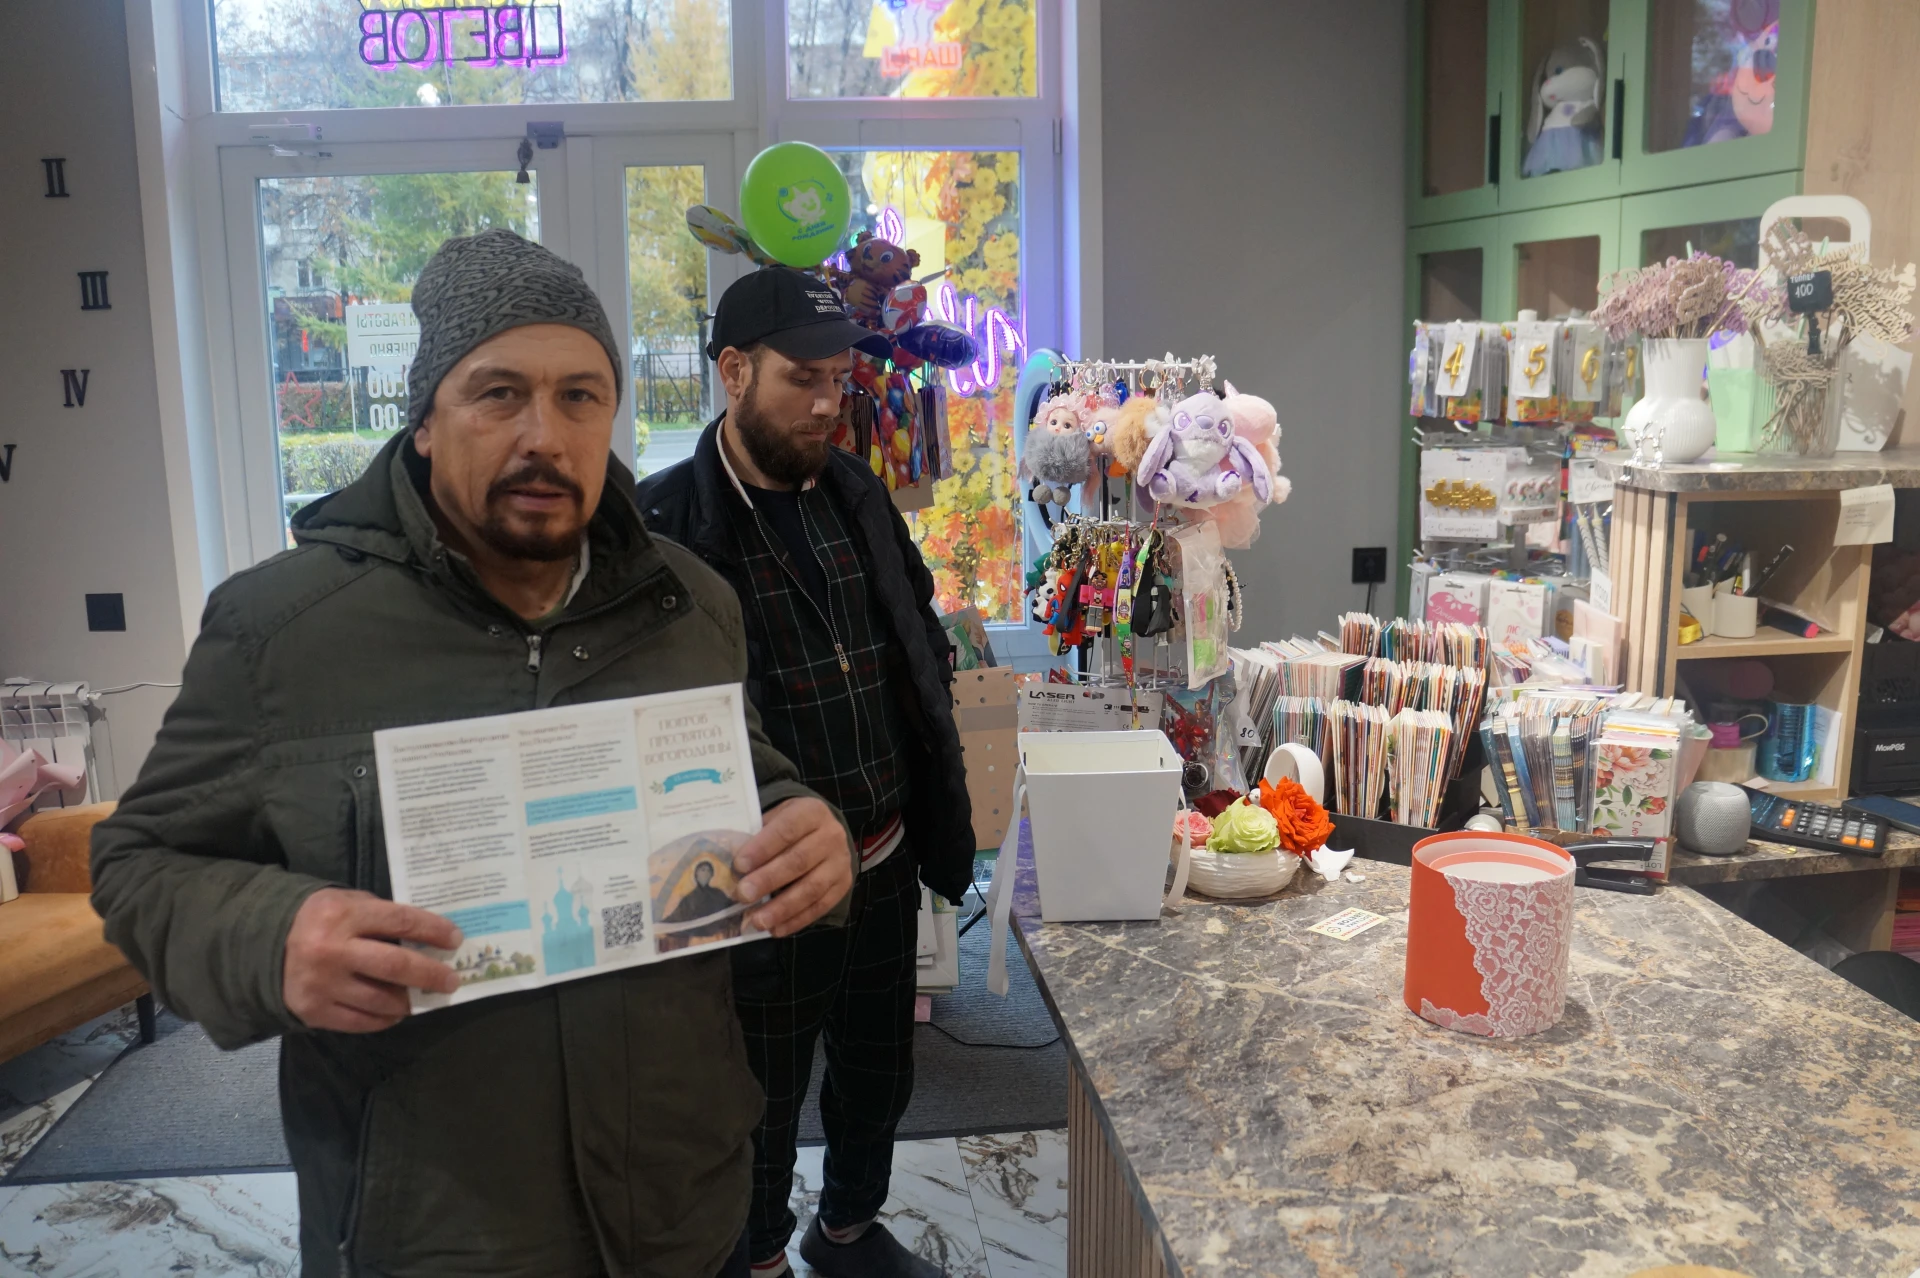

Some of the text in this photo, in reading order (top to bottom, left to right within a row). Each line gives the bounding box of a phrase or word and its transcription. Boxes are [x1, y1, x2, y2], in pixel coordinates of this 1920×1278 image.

[41, 158, 69, 197] II
[77, 271, 112, 310] III
[1795, 283, 1814, 298] 100
[60, 369, 90, 407] IV
[1029, 691, 1075, 700] LASER
[1240, 727, 1255, 738] 80
